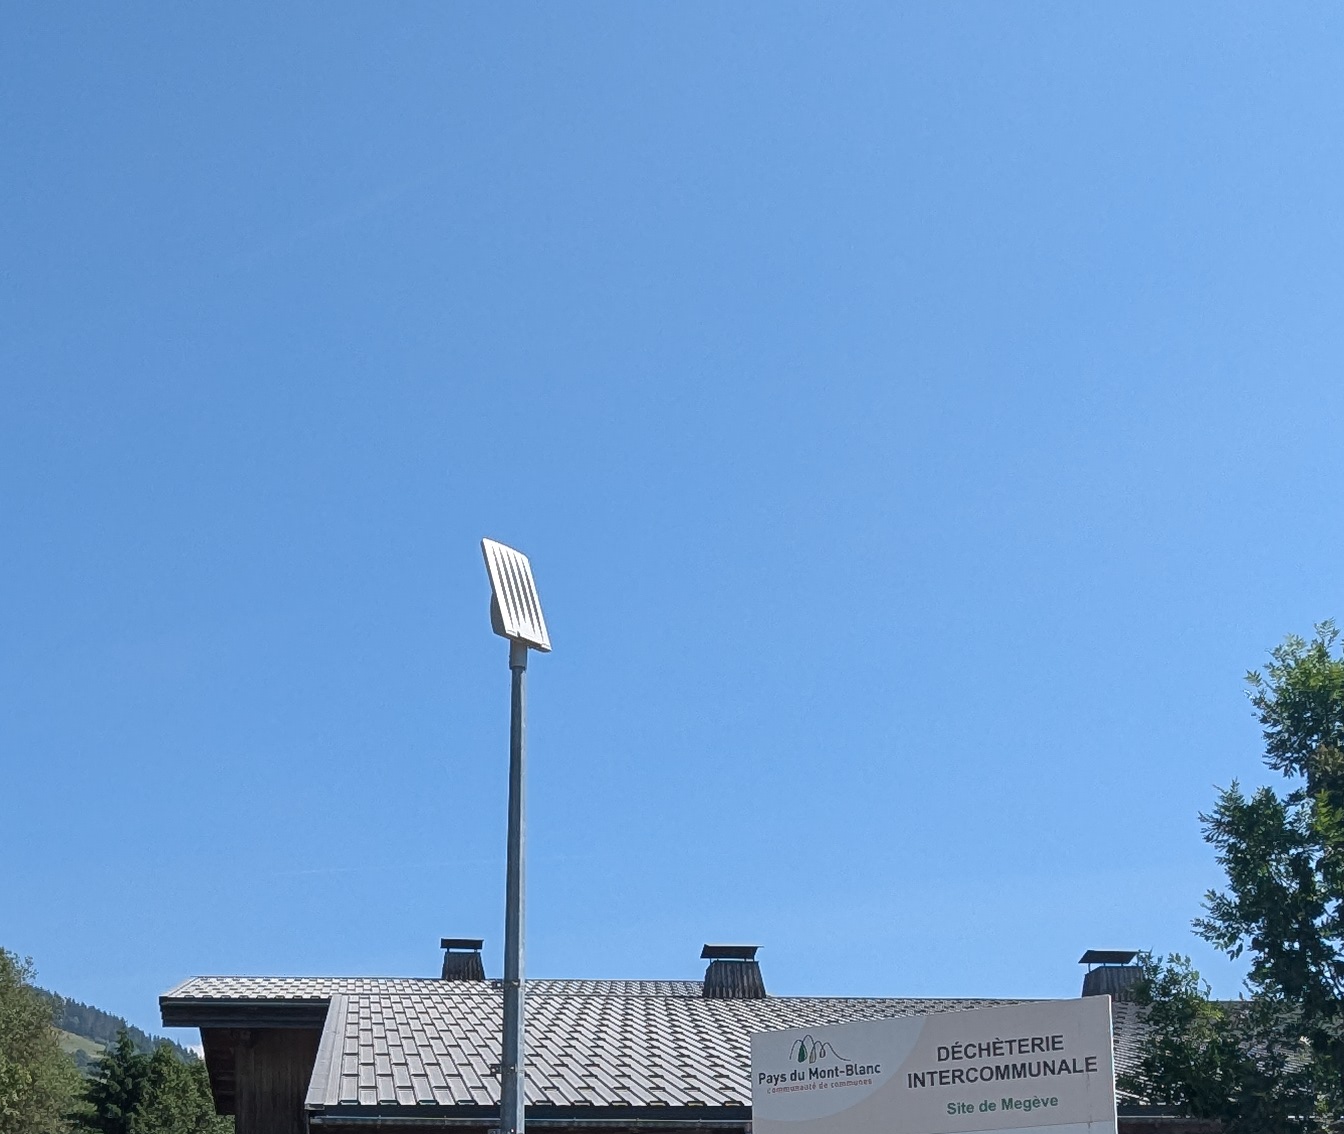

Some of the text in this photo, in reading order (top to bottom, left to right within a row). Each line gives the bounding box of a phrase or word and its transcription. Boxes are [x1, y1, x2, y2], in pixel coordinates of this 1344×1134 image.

[937, 1035, 1064, 1062] DÉCHÈTERIE
[758, 1063, 881, 1086] Pays du Mont-Blanc
[908, 1056, 1098, 1088] INTERCOMMUNALE
[947, 1095, 1059, 1115] Site de Megève
